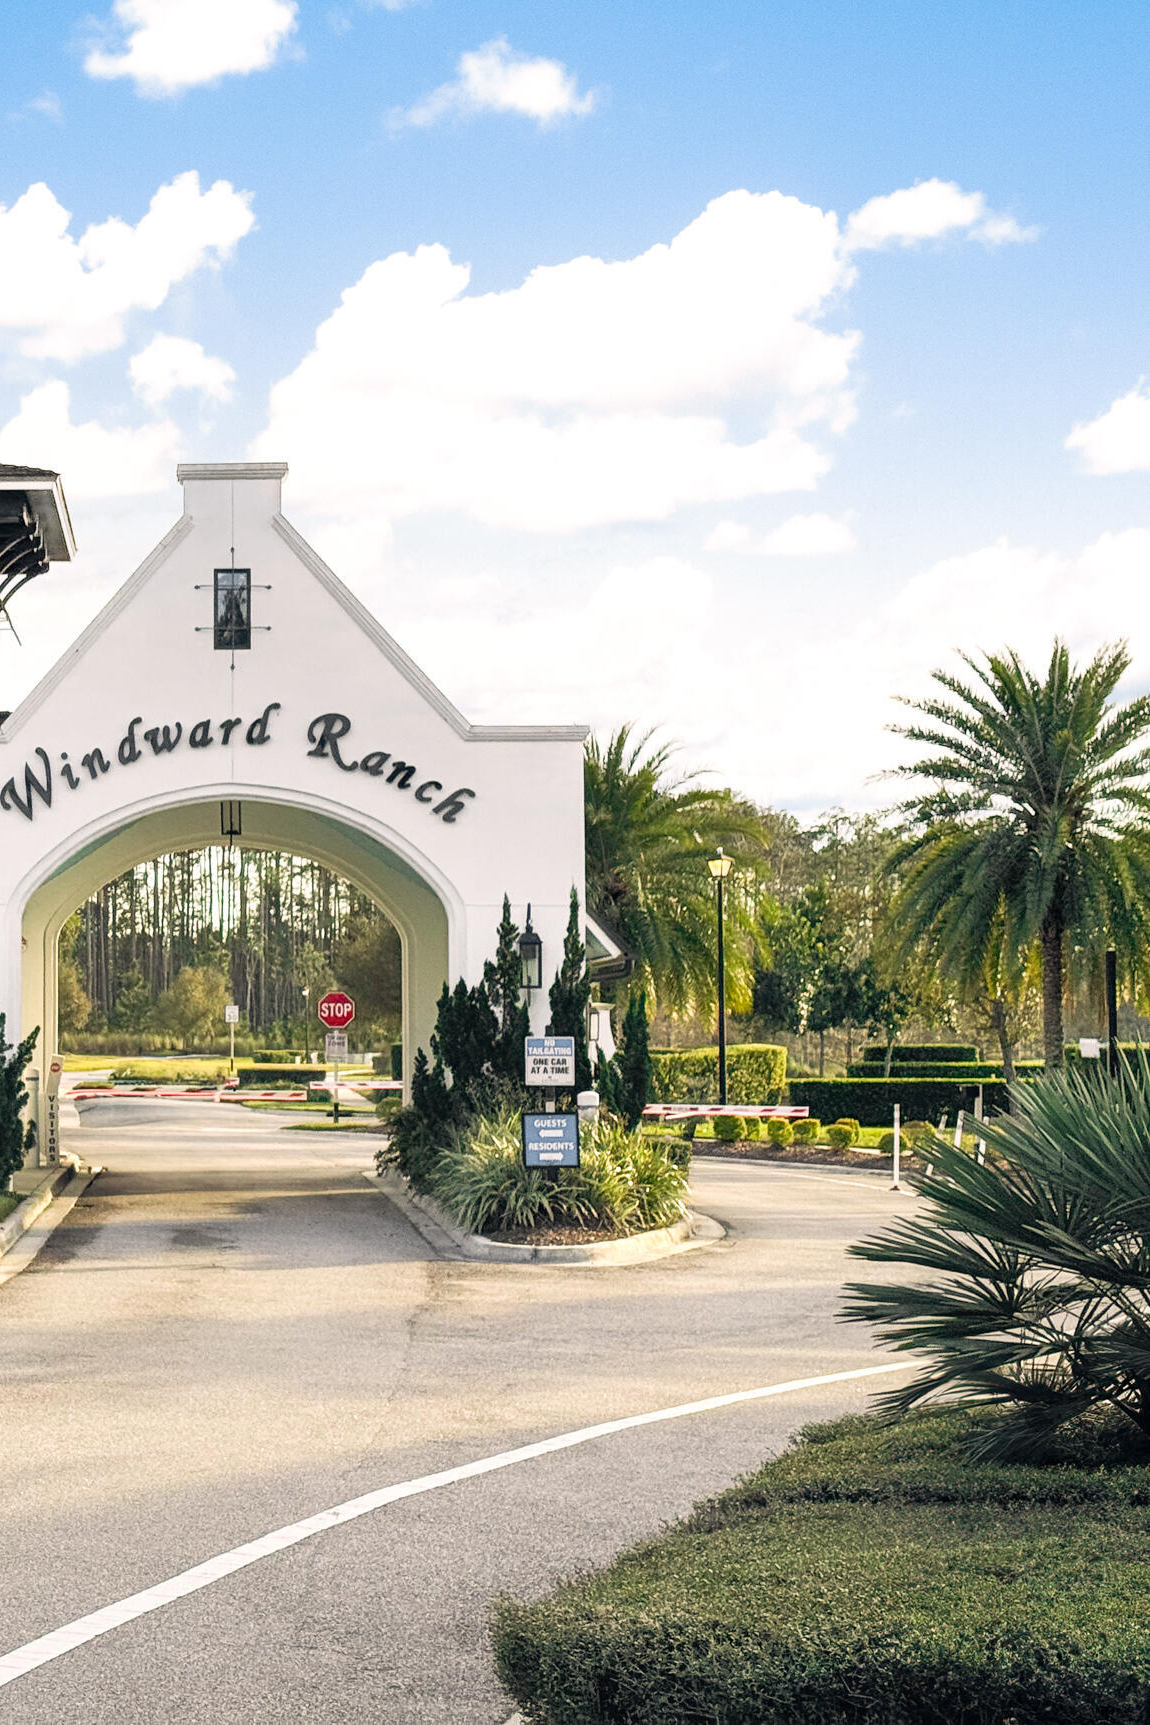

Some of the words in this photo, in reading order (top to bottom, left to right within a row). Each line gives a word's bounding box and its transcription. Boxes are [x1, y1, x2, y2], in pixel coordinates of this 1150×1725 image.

[0, 702, 281, 821] Windward
[306, 712, 476, 823] Ranch
[321, 1003, 352, 1017] STOP
[528, 1047, 572, 1055] TAILGATING
[533, 1058, 549, 1066] ONE
[551, 1058, 567, 1066] CAR
[531, 1066, 541, 1074] AT
[543, 1066, 548, 1074] A
[551, 1066, 569, 1074] TIME
[534, 1119, 567, 1128] GUESTS
[48, 1095, 56, 1162] VISITORS
[528, 1142, 575, 1150] RESIDENTS
